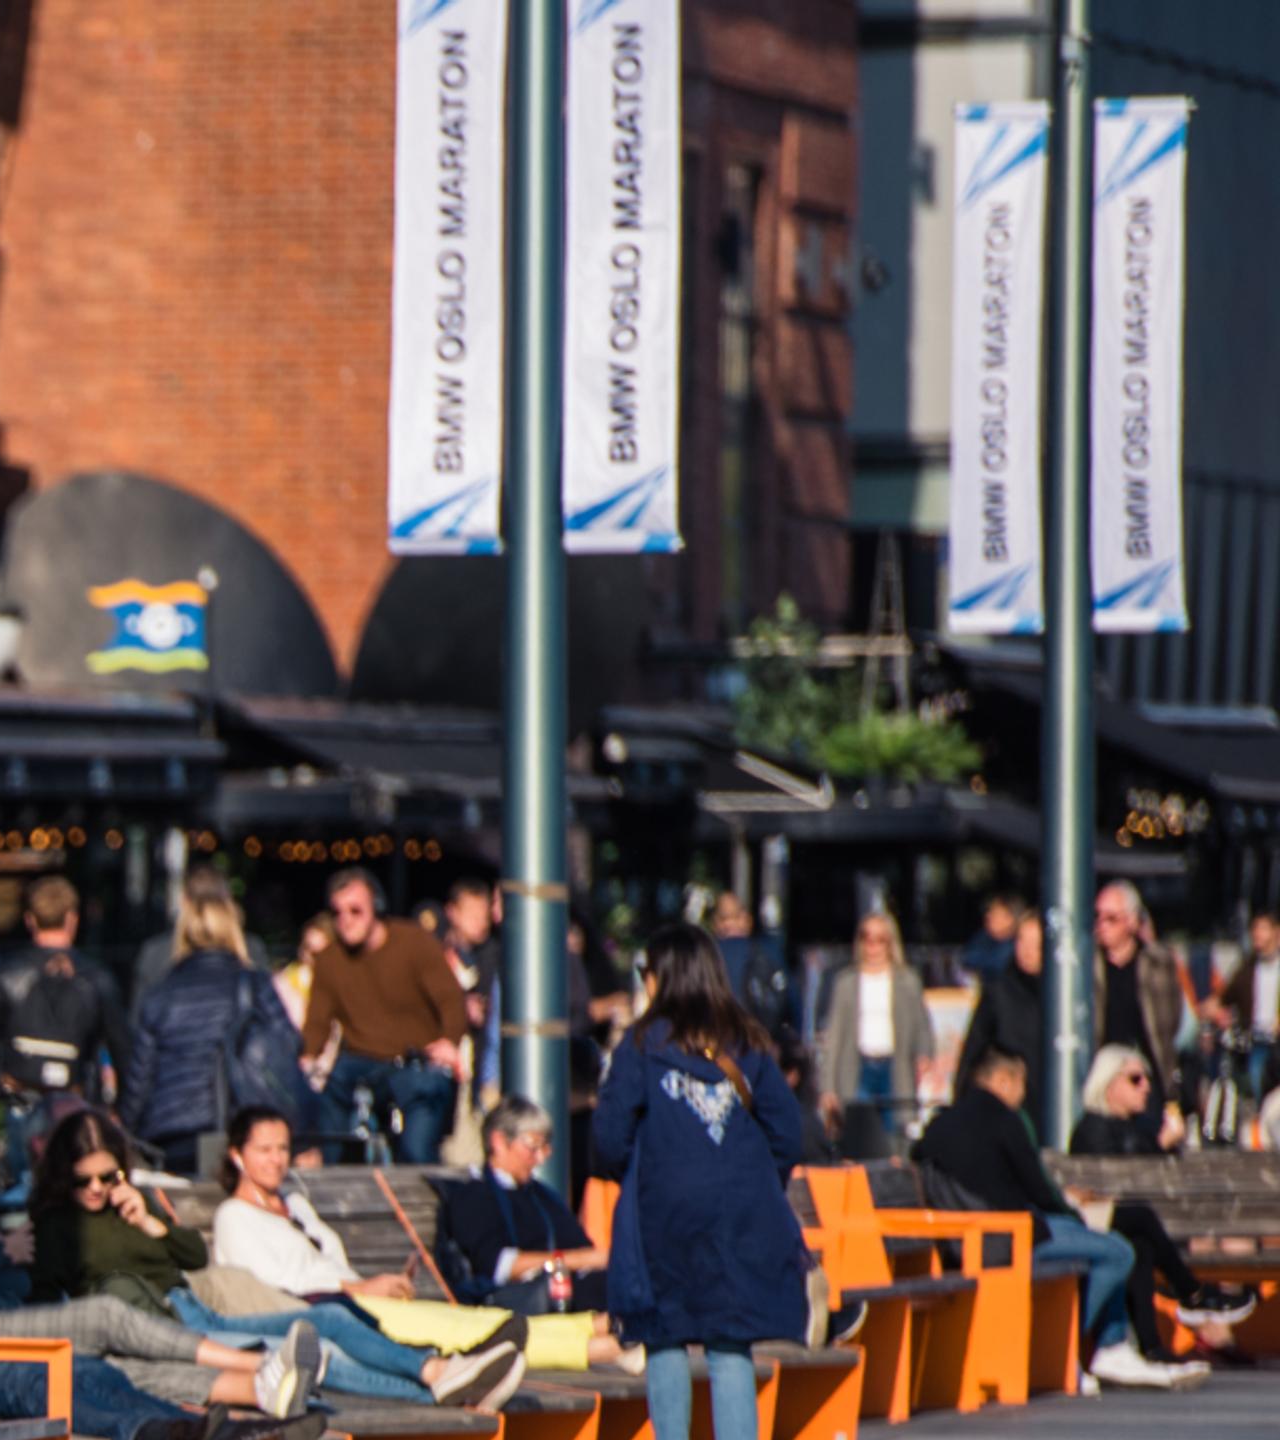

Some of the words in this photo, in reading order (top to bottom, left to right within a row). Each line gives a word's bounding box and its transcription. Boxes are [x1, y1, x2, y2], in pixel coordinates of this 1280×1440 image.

[438, 30, 469, 238] MARATON
[611, 22, 643, 231] MARATON
[436, 250, 467, 363] OSLO
[609, 243, 642, 353] OSLO
[433, 375, 465, 473] BMW
[608, 362, 638, 464] BMW
